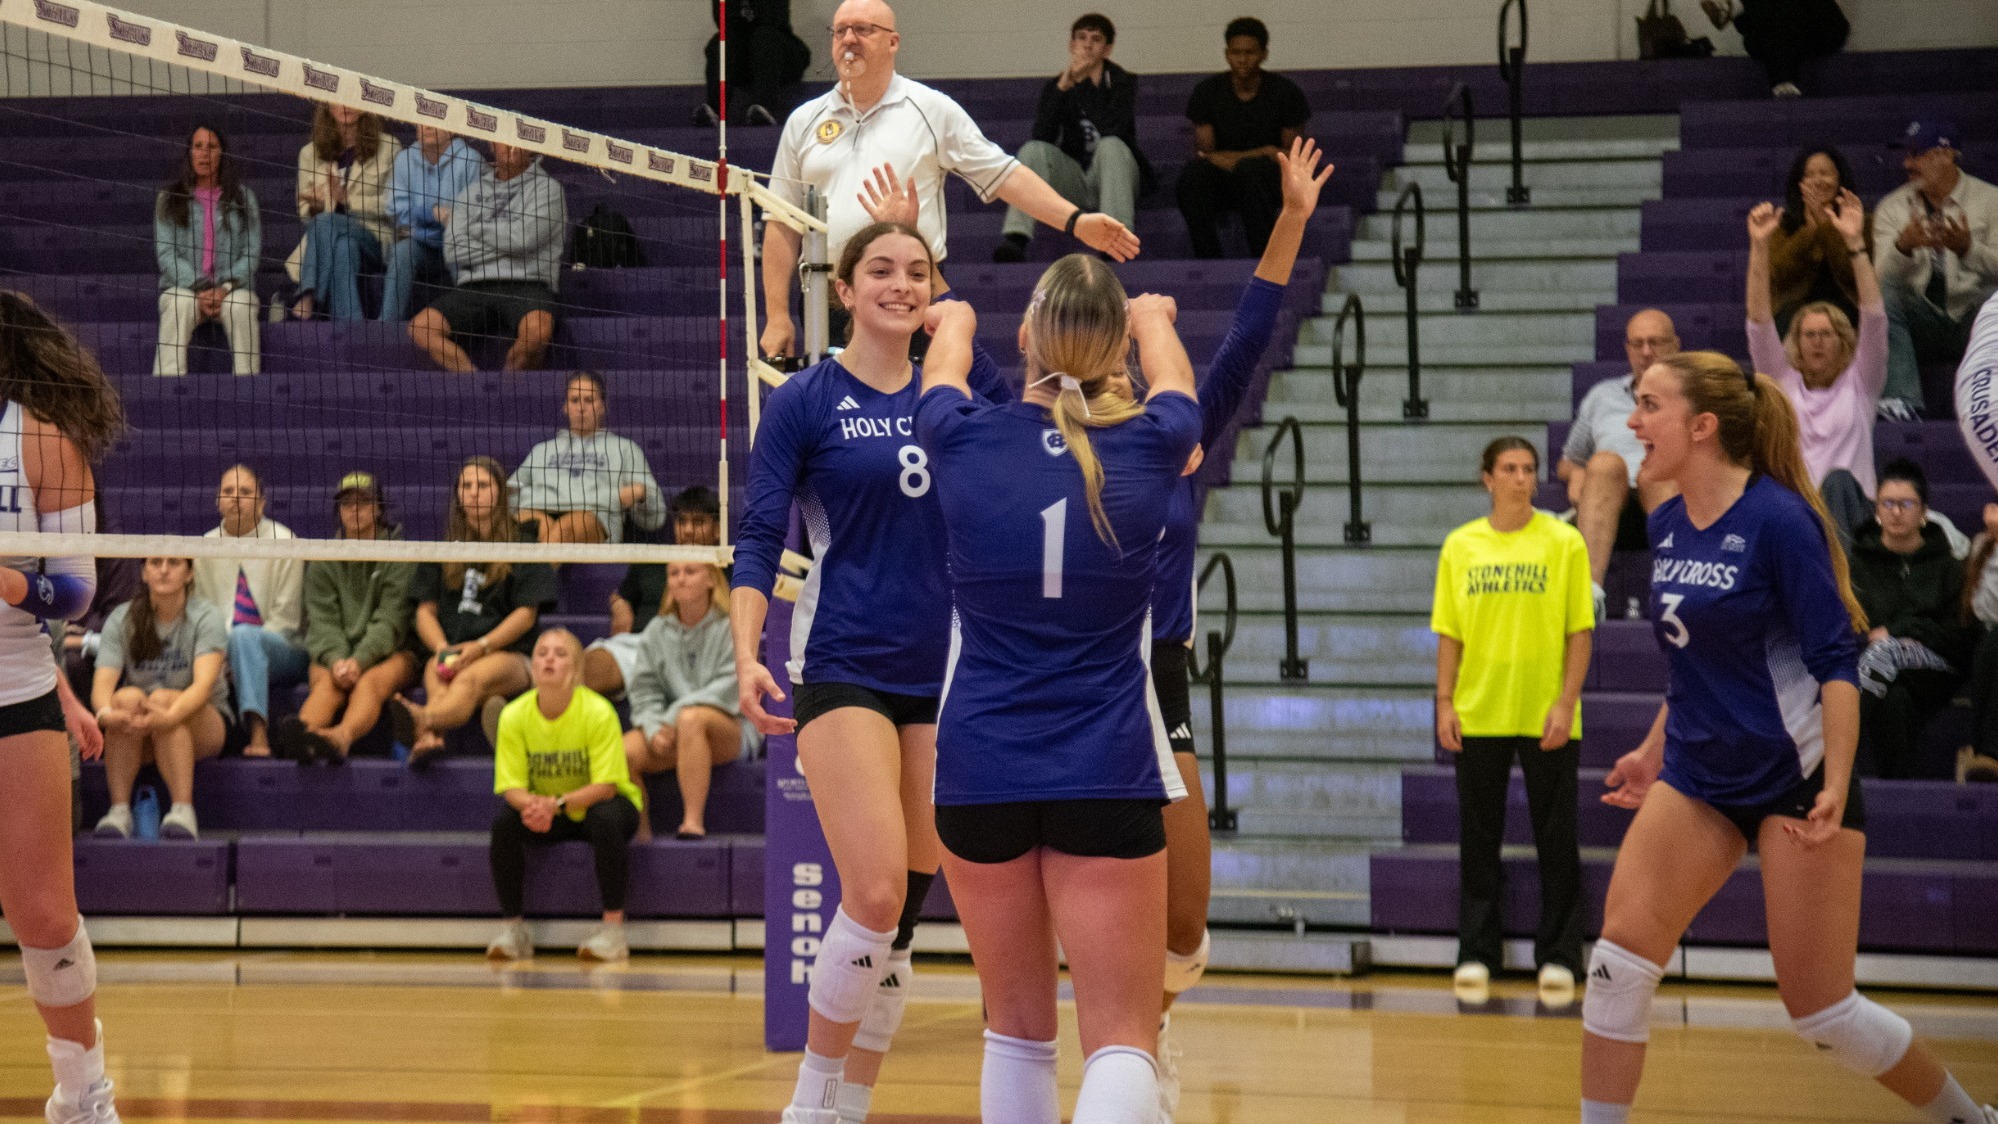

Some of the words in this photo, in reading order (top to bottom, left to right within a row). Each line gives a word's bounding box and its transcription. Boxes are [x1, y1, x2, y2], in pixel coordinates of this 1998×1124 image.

[840, 417, 892, 440] HOLY
[896, 416, 913, 436] C
[1969, 367, 1998, 463] CRUSADE
[898, 444, 931, 498] 8
[1040, 496, 1067, 598] 1
[1466, 564, 1547, 581] STONEHILL
[1467, 580, 1545, 596] ATHLETICS
[1679, 560, 1739, 590] CROSS
[1661, 592, 1690, 649] 3
